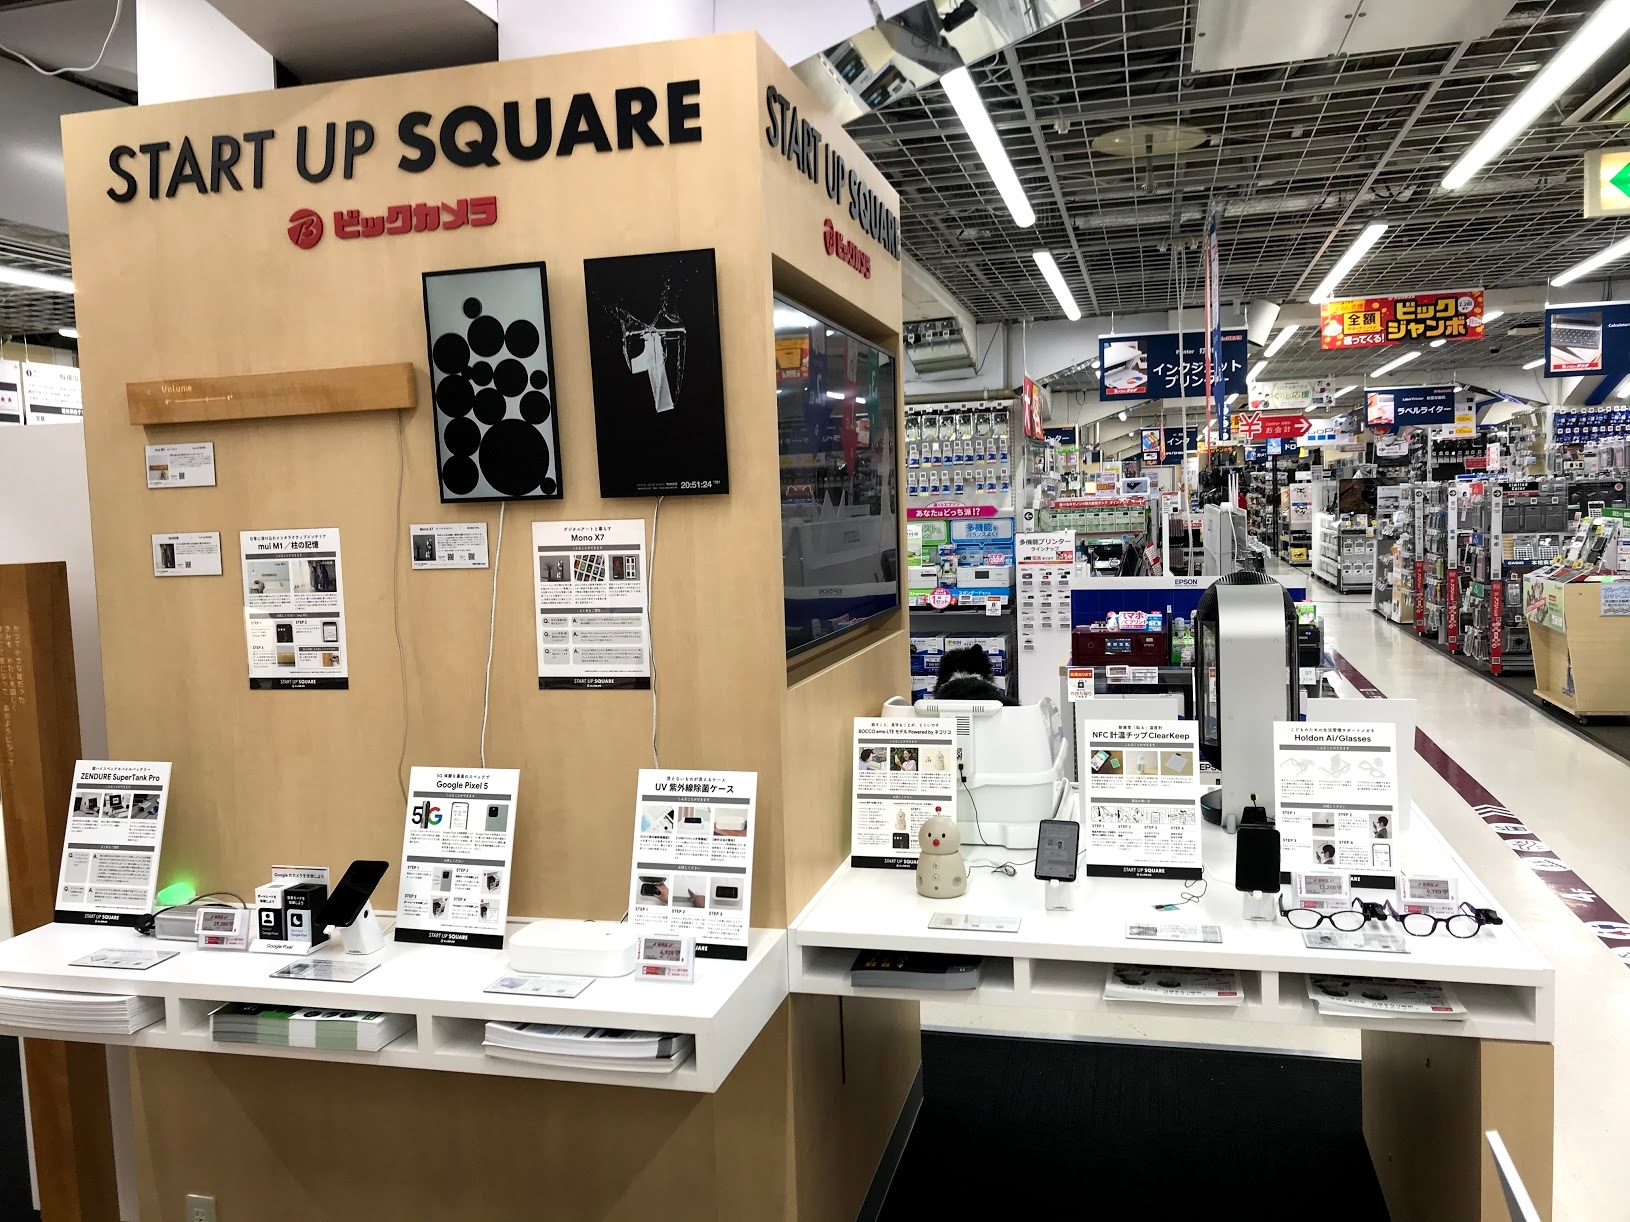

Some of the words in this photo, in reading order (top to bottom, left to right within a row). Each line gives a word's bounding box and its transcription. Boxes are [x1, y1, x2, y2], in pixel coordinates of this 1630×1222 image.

[107, 130, 275, 202] START
[296, 120, 375, 184] UP
[398, 80, 702, 173] SQUARE
[766, 85, 822, 184] START
[825, 143, 845, 205] UP
[849, 169, 900, 261] SQUARE
[334, 196, 498, 240] ビックカメラ
[1396, 298, 1456, 320] ビック
[1348, 313, 1376, 326] 全額
[1388, 317, 1466, 339] ジャンボ
[162, 385, 192, 393] Volume
[1398, 406, 1451, 415] ラベルライター
[916, 508, 980, 517] あなたはどっち派!?
[112, 774, 147, 782] SuperTank
[437, 781, 463, 790] Google
[465, 781, 482, 789] Pixel
[669, 783, 734, 793] 紫外線除菌ケース
